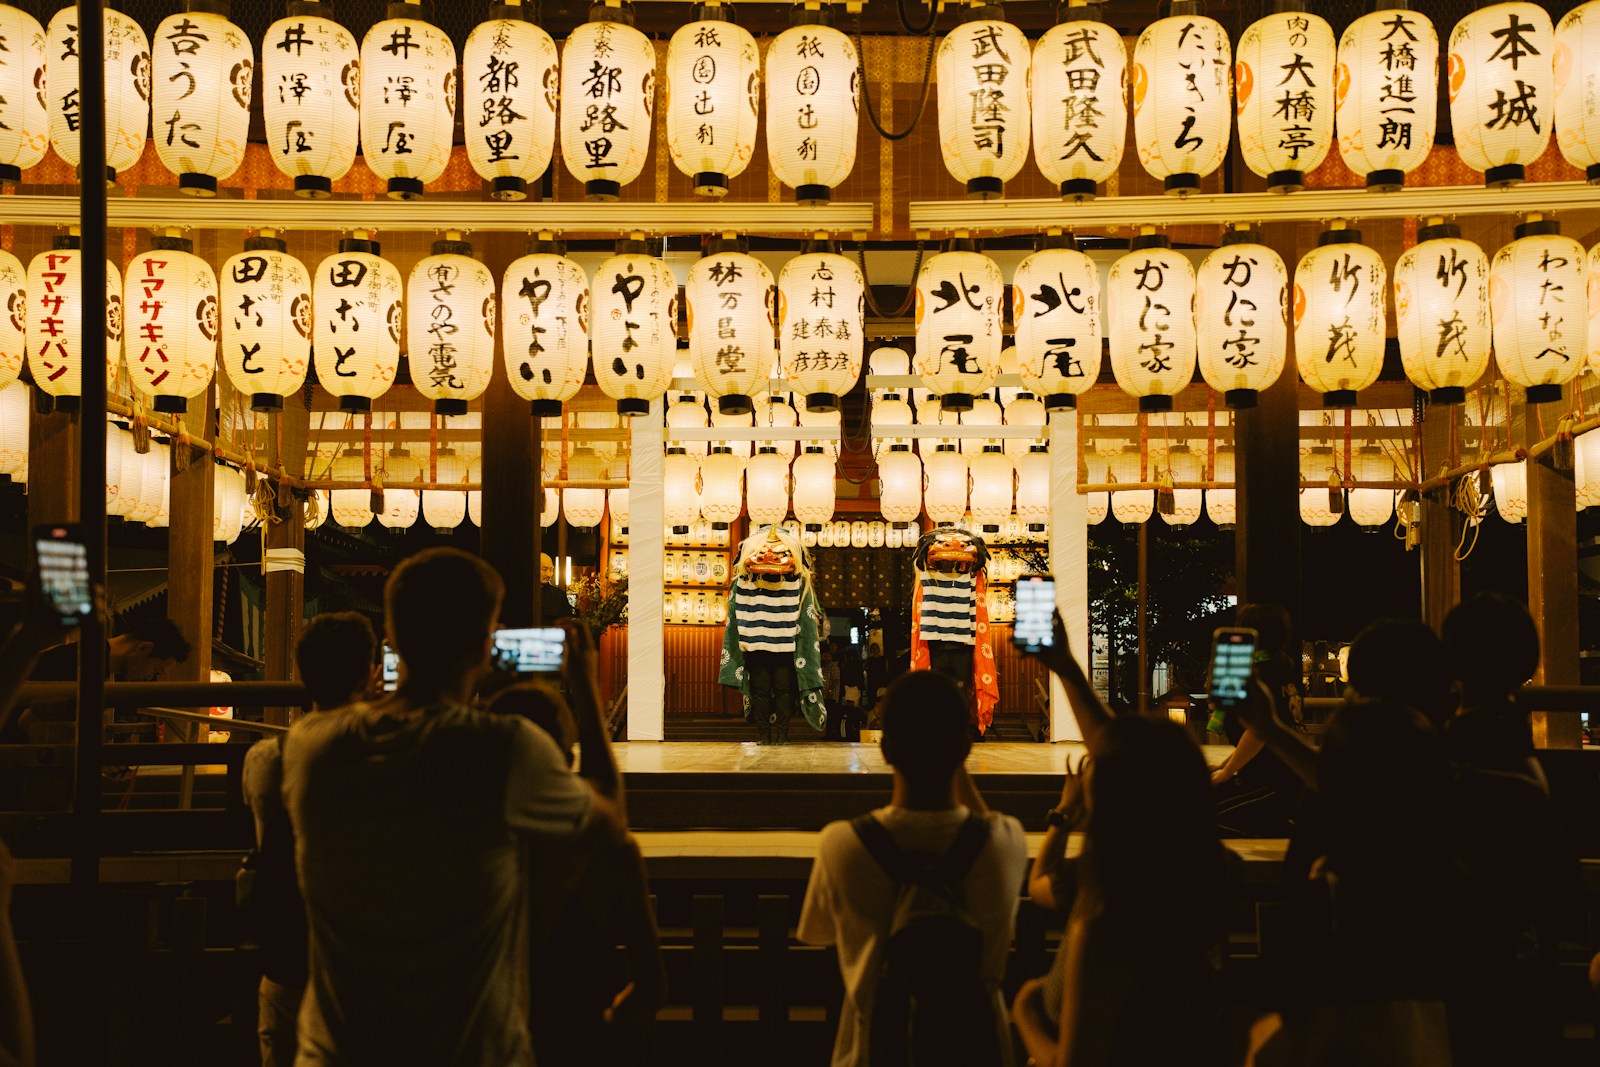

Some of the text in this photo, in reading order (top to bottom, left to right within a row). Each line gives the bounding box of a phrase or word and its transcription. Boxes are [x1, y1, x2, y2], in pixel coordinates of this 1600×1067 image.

[106, 15, 122, 61] 懐石料理
[165, 18, 210, 149] 吉うた
[276, 23, 314, 155] 井澤屋
[381, 26, 420, 155] 井澤屋
[479, 19, 528, 164] 茶寮都路里
[579, 22, 629, 169] 茶寮都路里
[968, 25, 1012, 159] 武田隆司
[1059, 28, 1105, 163] 武田隆久
[1272, 15, 1317, 161] 肉の大橋亭
[1485, 13, 1541, 135] 本城
[39, 253, 72, 382] ヤマザキパン
[139, 258, 170, 387] ヤマザキパン
[518, 266, 552, 385] やよい
[611, 262, 646, 381] やよい
[707, 261, 746, 375] 林万昌堂
[930, 271, 984, 375] 北尾
[1030, 271, 1086, 379] 北尾
[1133, 259, 1175, 374] かに家
[1222, 254, 1261, 369] かに家
[1535, 249, 1571, 363] わたなべ
